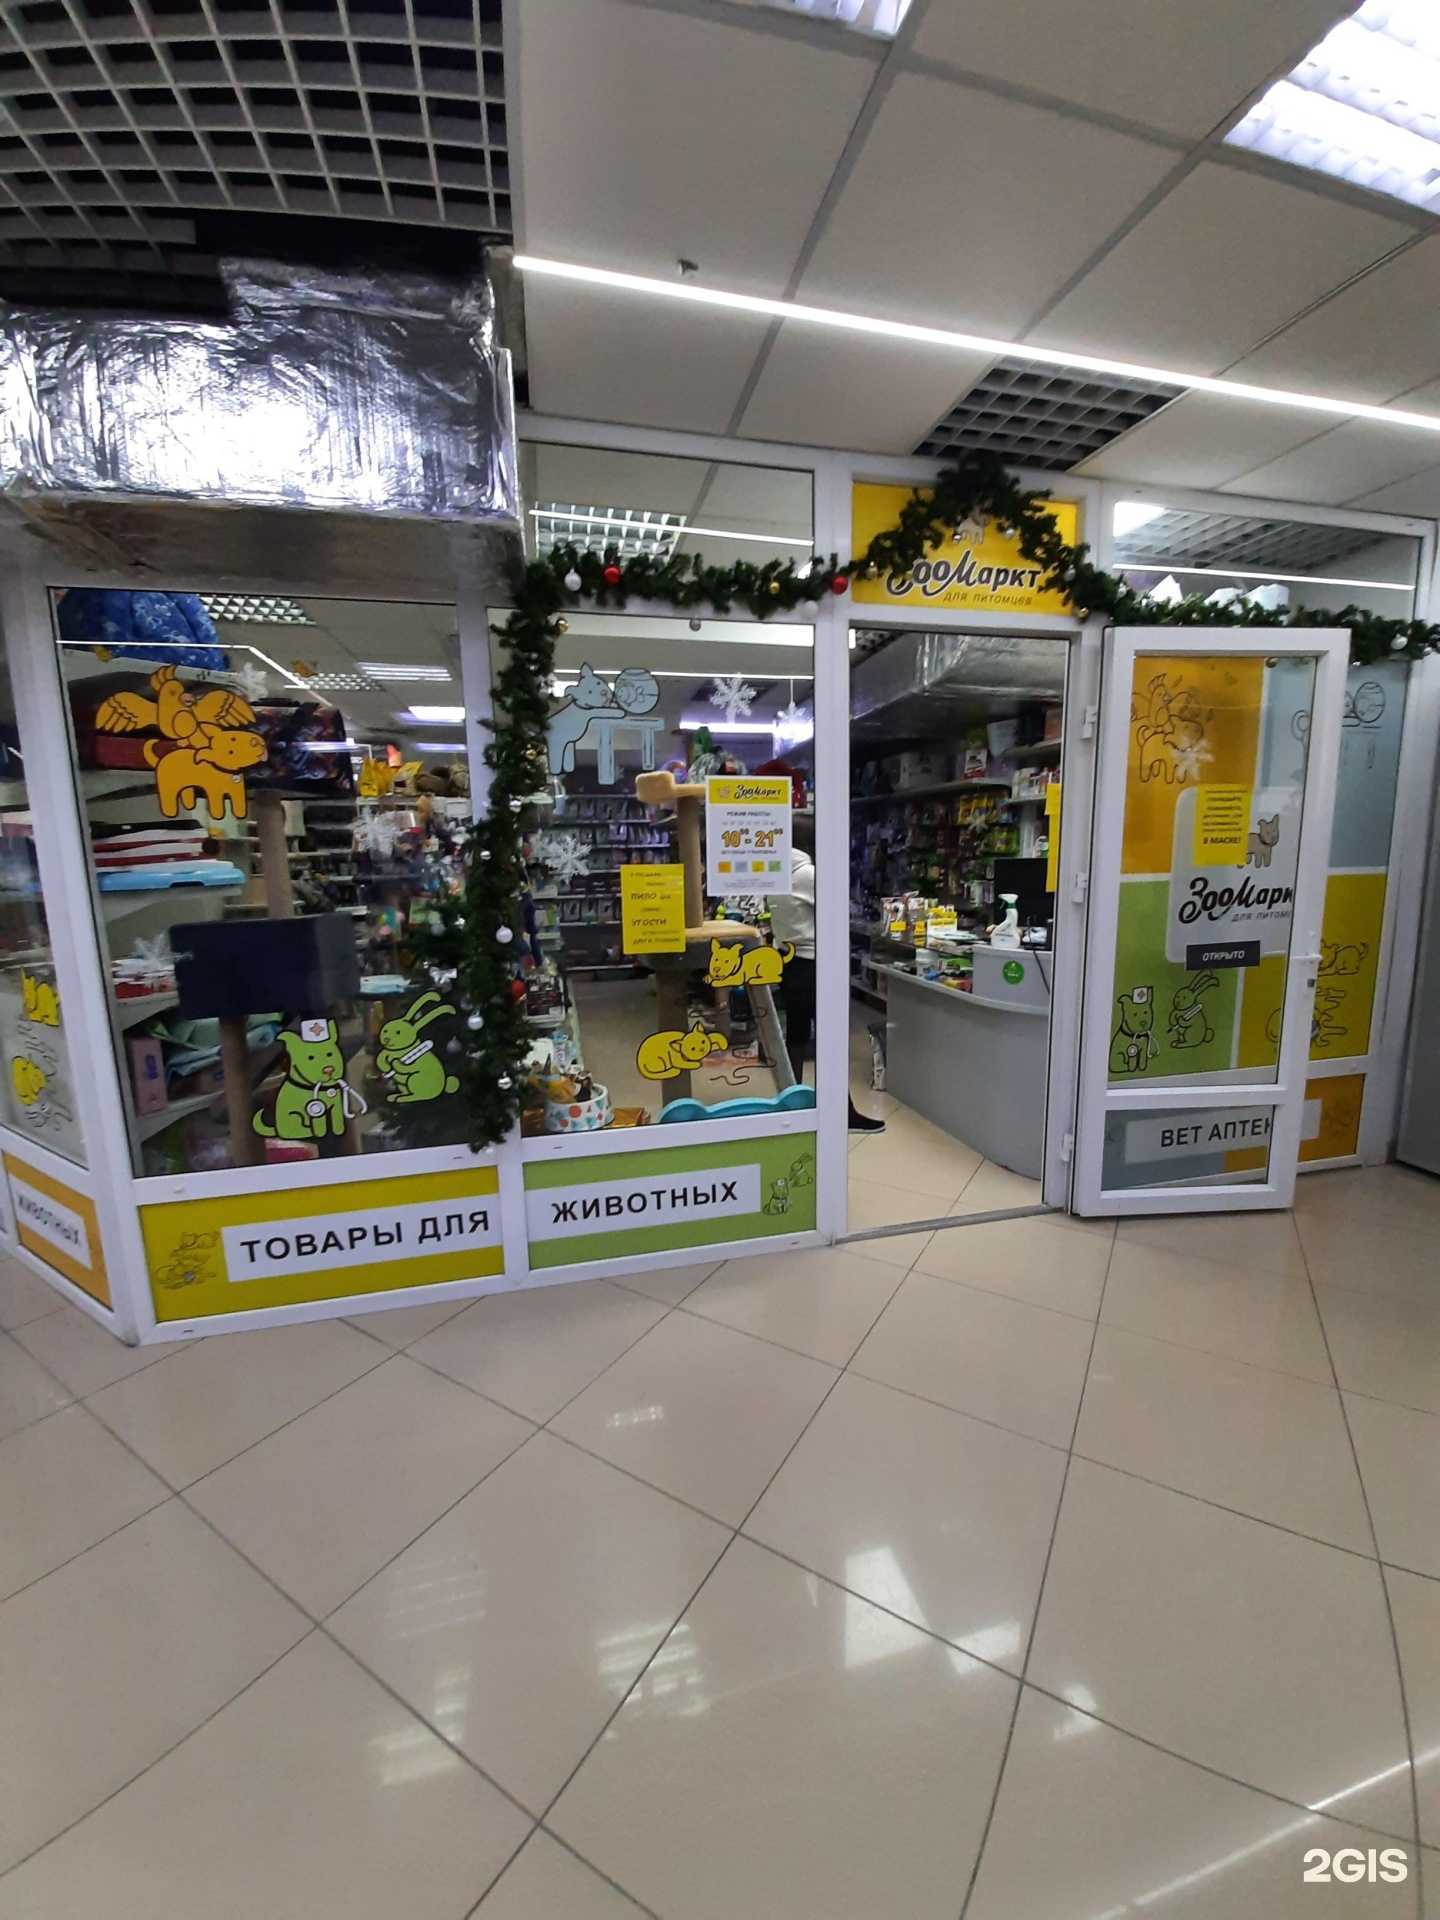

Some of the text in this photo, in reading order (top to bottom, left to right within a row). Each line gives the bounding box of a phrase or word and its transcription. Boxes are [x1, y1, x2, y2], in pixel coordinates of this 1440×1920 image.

[1202, 950, 1245, 961] ОТКРЫТО
[1161, 1125, 1203, 1148] ВЕТ
[240, 1180, 738, 1264] ТОВАРЫ ДЛЯ ЖИВОТНЫХ
